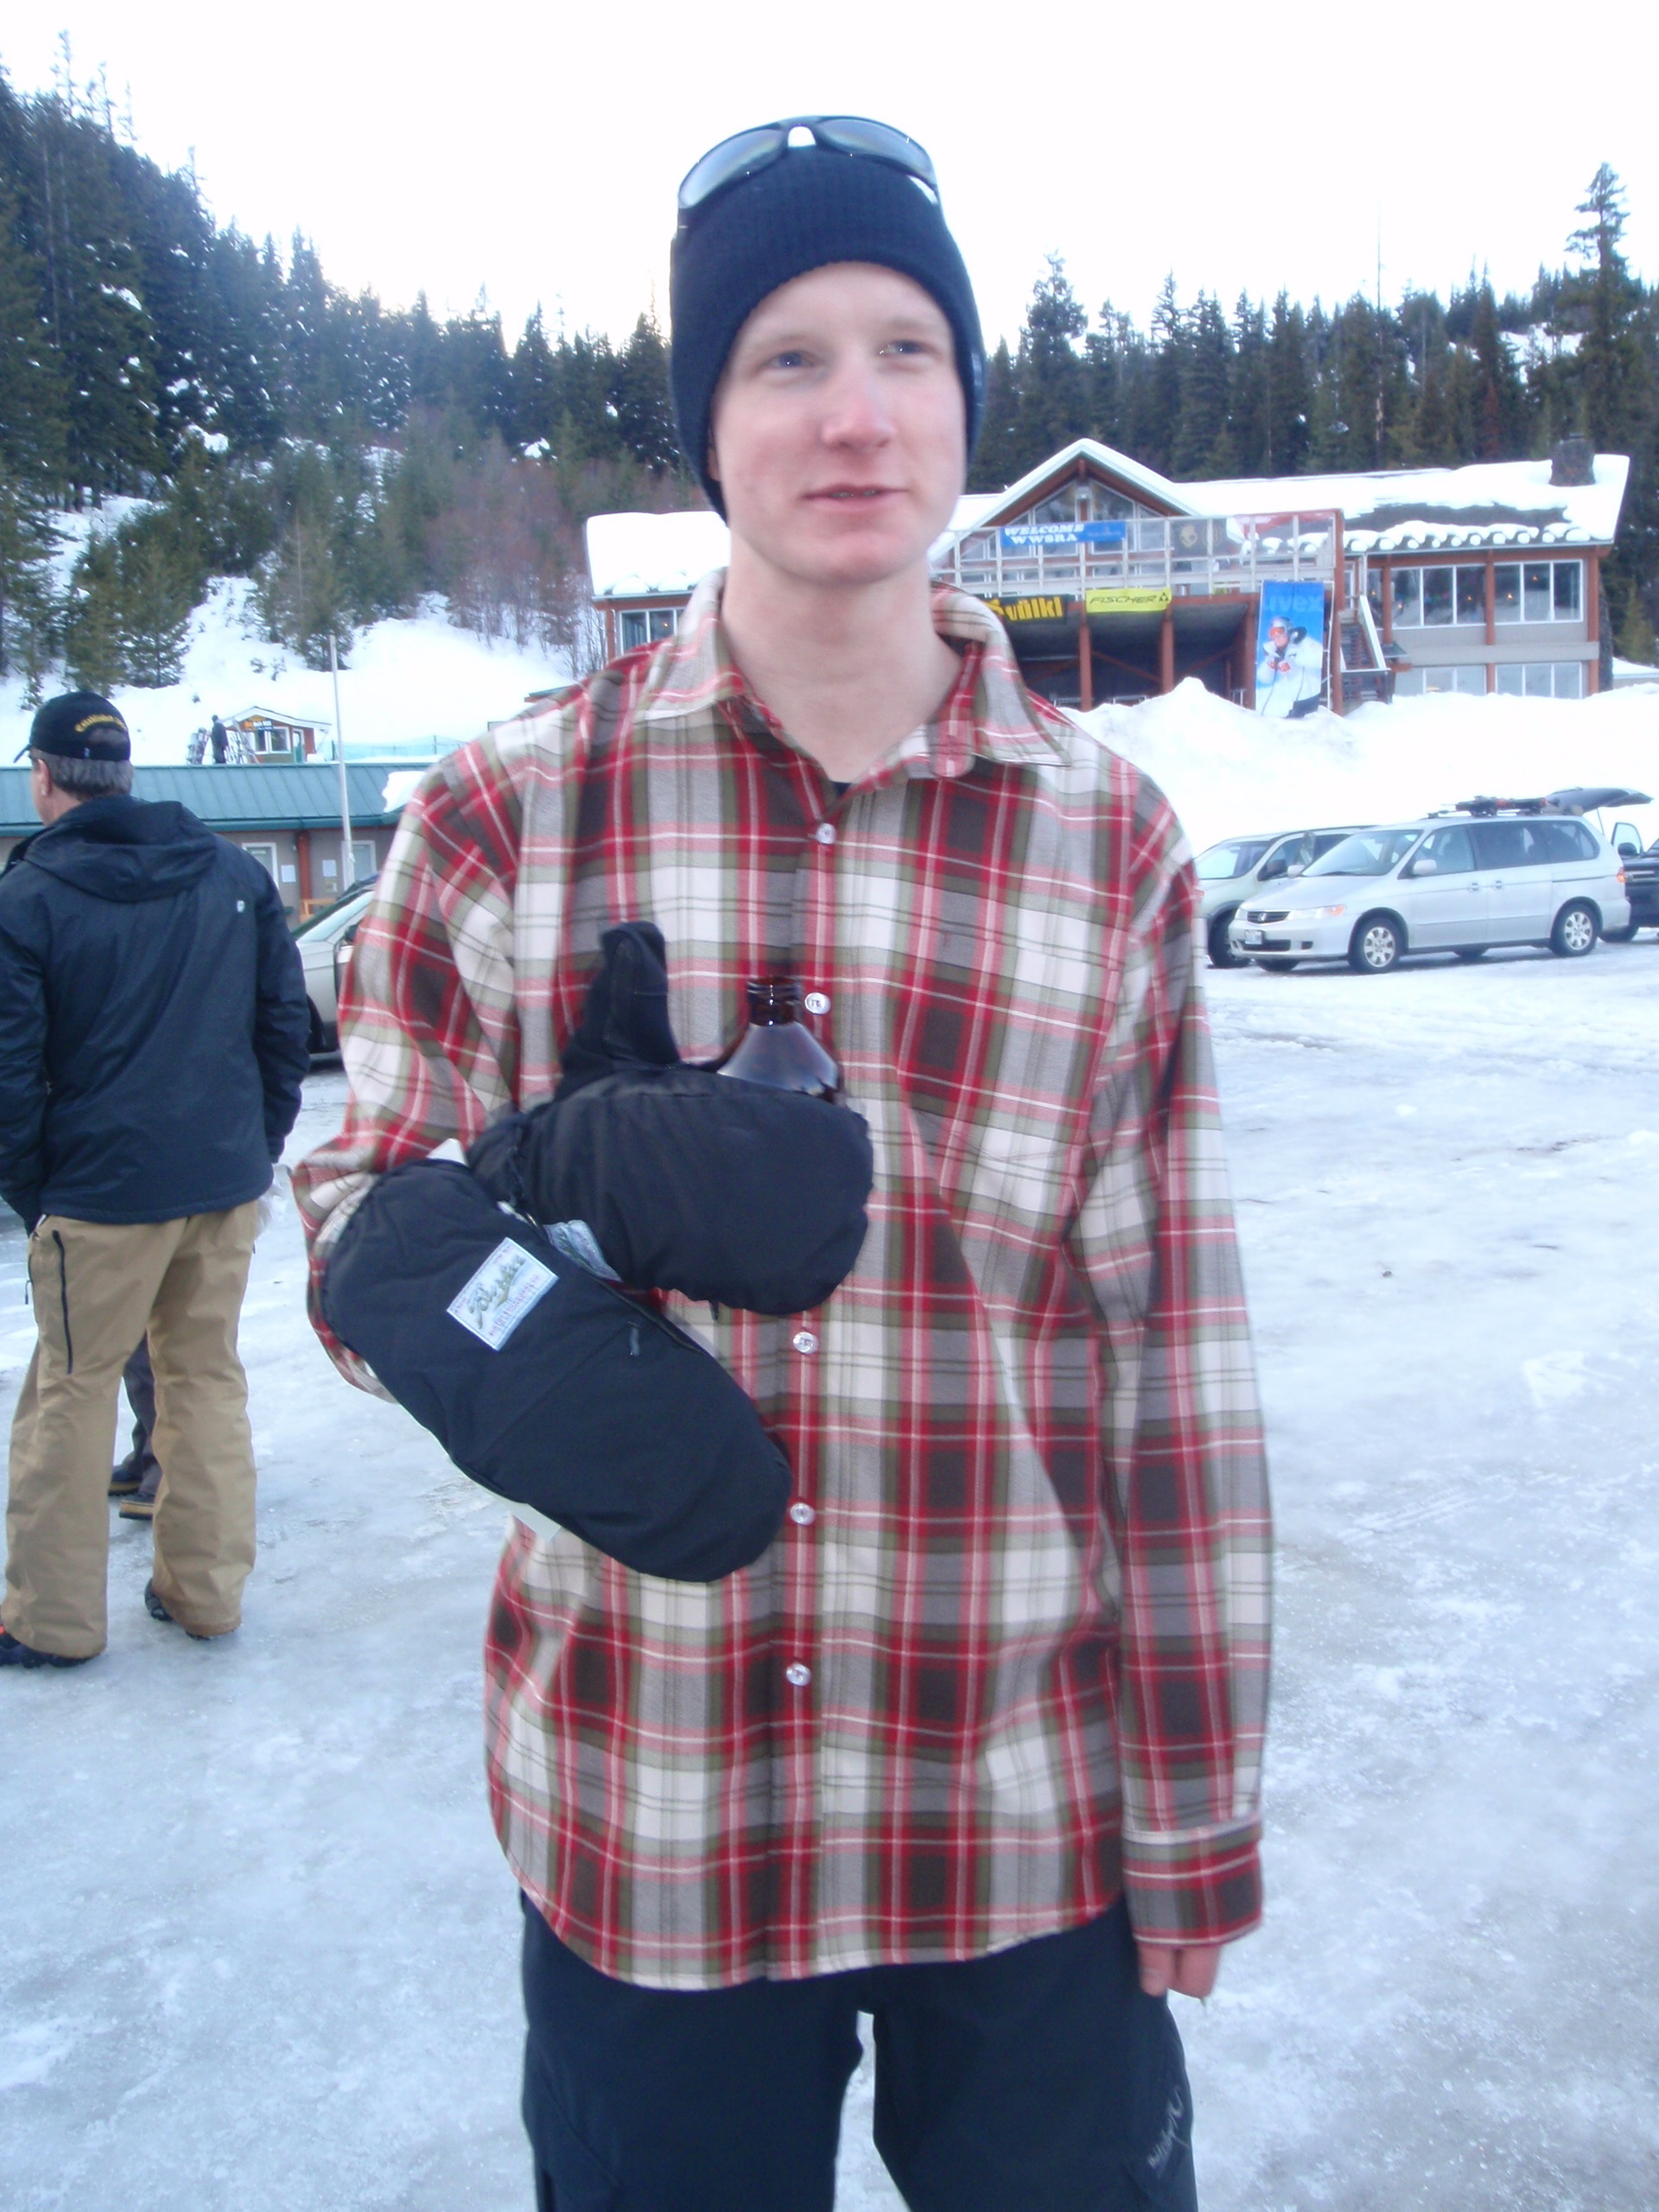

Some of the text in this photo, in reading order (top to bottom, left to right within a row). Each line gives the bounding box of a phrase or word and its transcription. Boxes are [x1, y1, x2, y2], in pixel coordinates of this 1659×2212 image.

[1005, 524, 1084, 536] WELCOME
[1010, 533, 1077, 544] WWSRA
[1089, 595, 1157, 604] FISCHER
